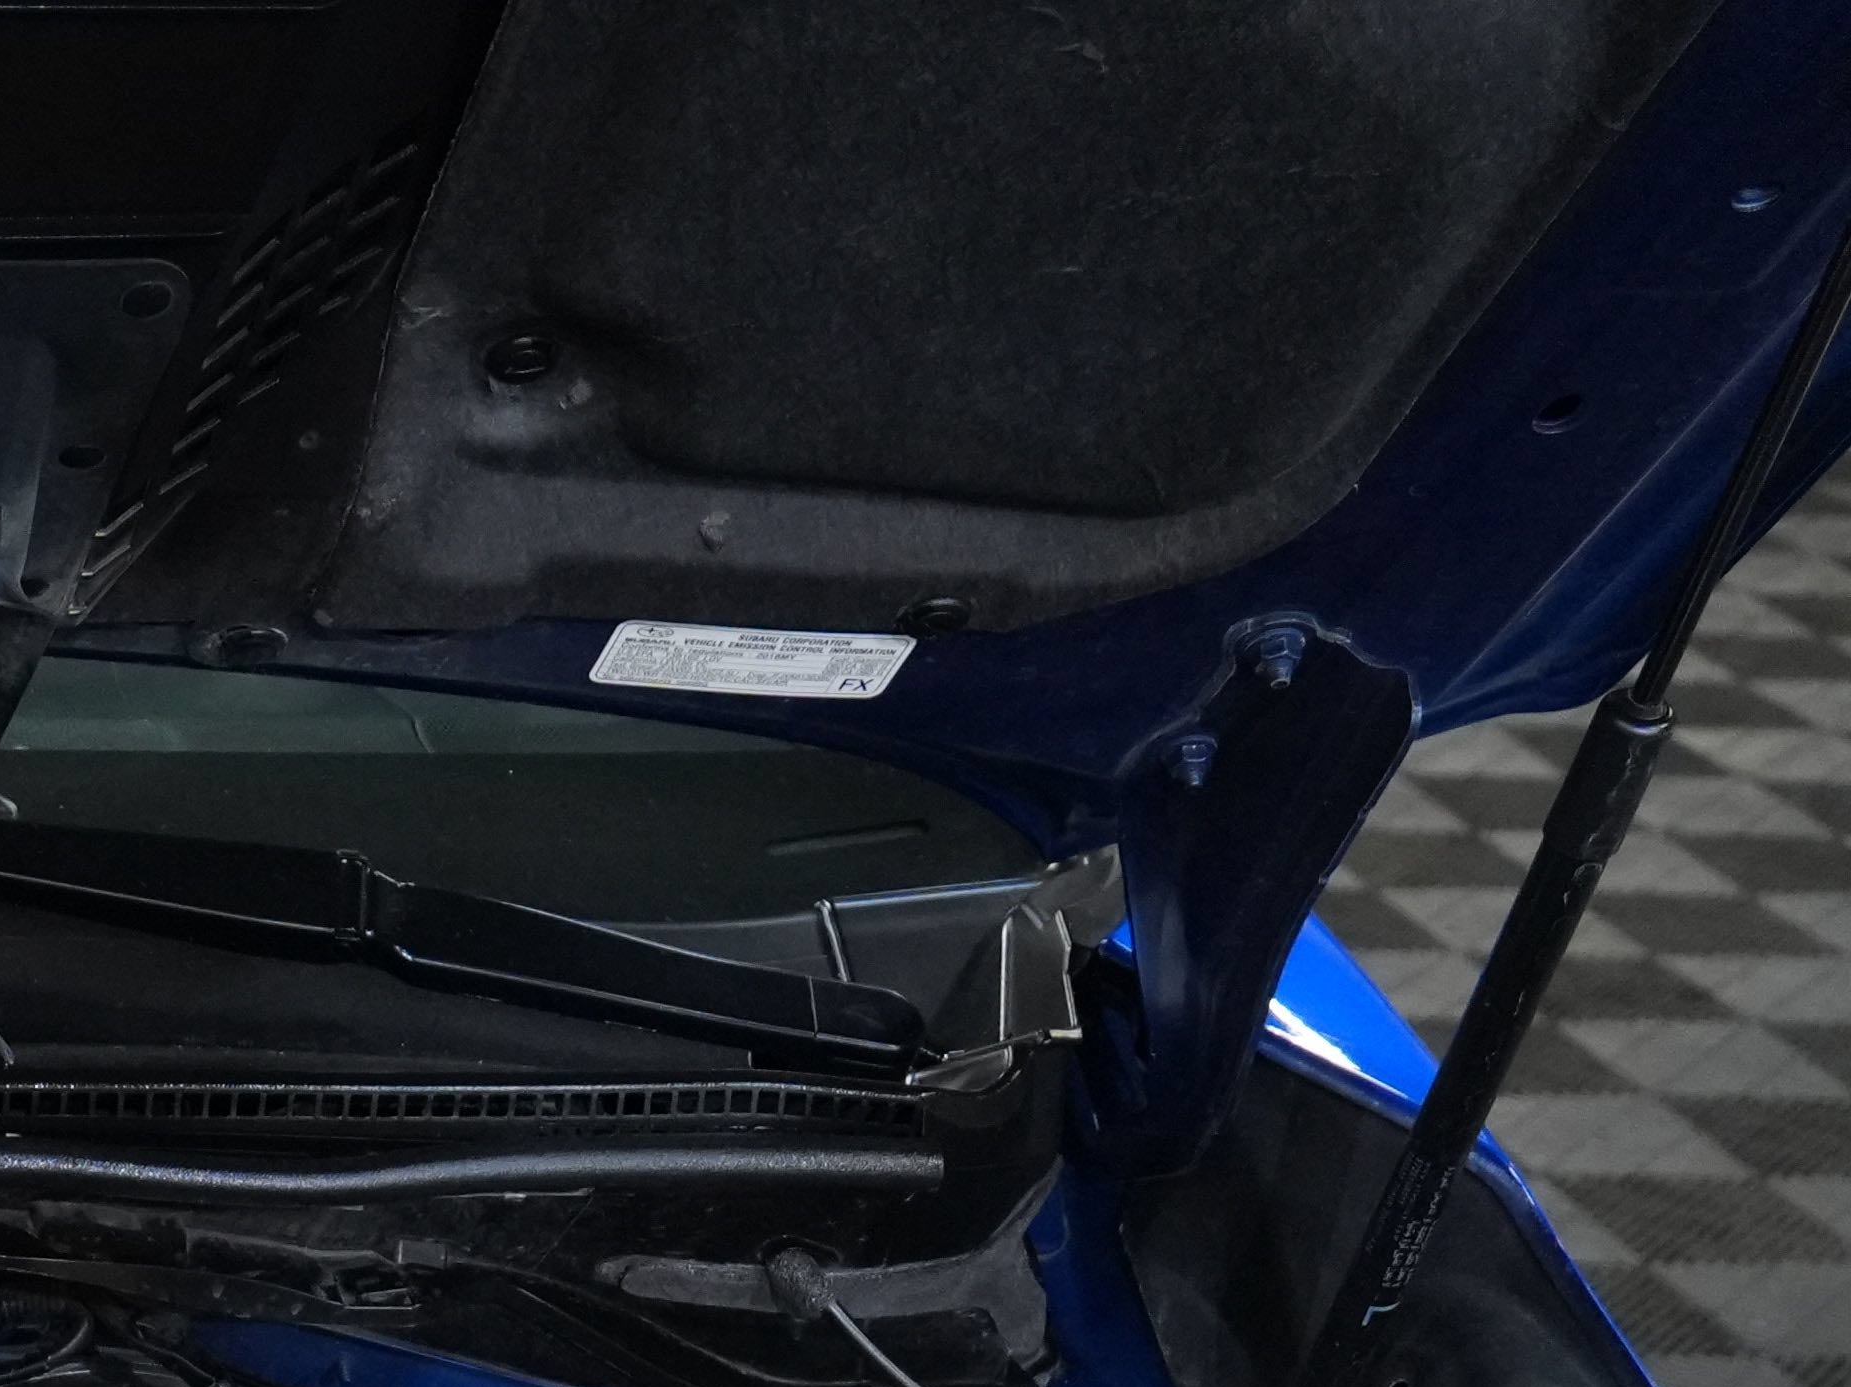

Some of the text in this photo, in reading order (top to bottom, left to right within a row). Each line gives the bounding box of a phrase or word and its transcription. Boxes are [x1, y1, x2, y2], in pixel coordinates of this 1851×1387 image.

[684, 638, 896, 656] VEHICLE EMISSION CONTROL INFORMATION
[783, 637, 852, 646] CORPORATION
